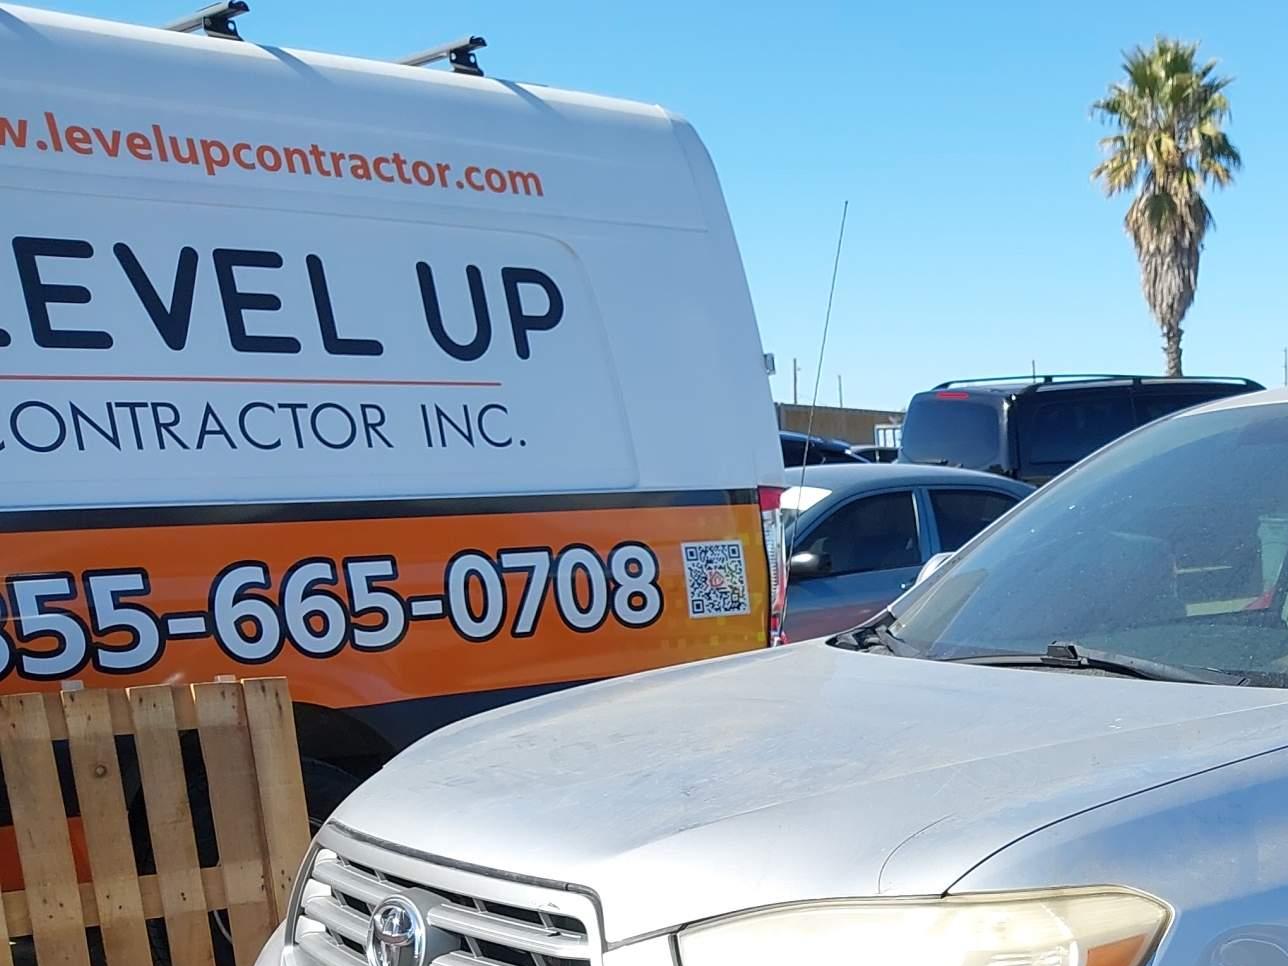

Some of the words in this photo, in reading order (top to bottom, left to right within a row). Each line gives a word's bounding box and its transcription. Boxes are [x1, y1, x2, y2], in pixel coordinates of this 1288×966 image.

[0, 236, 385, 356] EVEL
[415, 261, 564, 361] UP
[0, 400, 394, 452] ONTRACTOR
[420, 403, 527, 449] INC.
[0, 540, 664, 682] 55-665-0708
